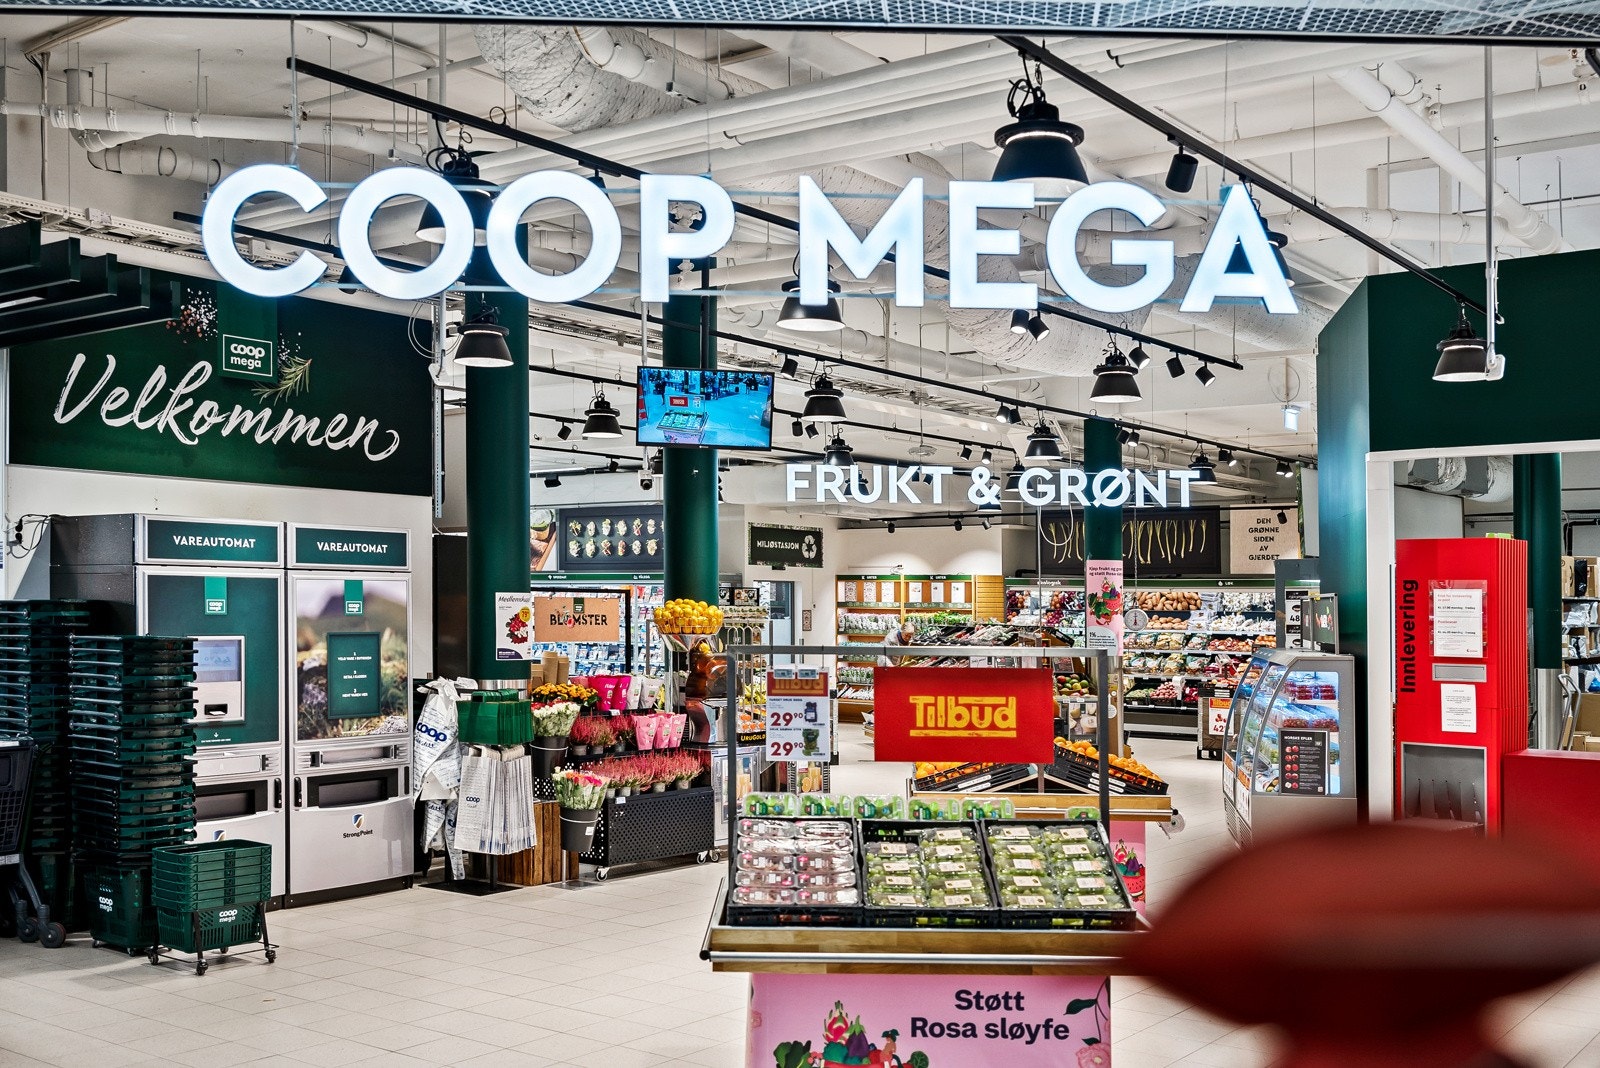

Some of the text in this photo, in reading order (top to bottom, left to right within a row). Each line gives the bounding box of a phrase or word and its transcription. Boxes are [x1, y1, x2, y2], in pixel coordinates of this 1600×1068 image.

[201, 163, 1299, 315] COOP MEGA
[230, 343, 266, 359] coop
[230, 356, 262, 369] mega
[53, 352, 401, 462] Velkommen
[785, 464, 1201, 508] FRUKT & GRØNT
[172, 535, 257, 549] VAREAUTOMAT
[316, 541, 389, 554] VAREAUTOMAT
[756, 540, 800, 550] MILJØSTASJON
[1399, 579, 1419, 693] Innlevering
[909, 695, 1017, 729] Tilbud
[416, 722, 448, 742] coop
[342, 829, 374, 839] StrongPoint
[98, 896, 114, 906] coop
[218, 909, 238, 918] coop
[218, 915, 236, 923] mega
[954, 989, 1025, 1012] Støtt
[910, 1017, 1070, 1045] Rosa sløyfe
